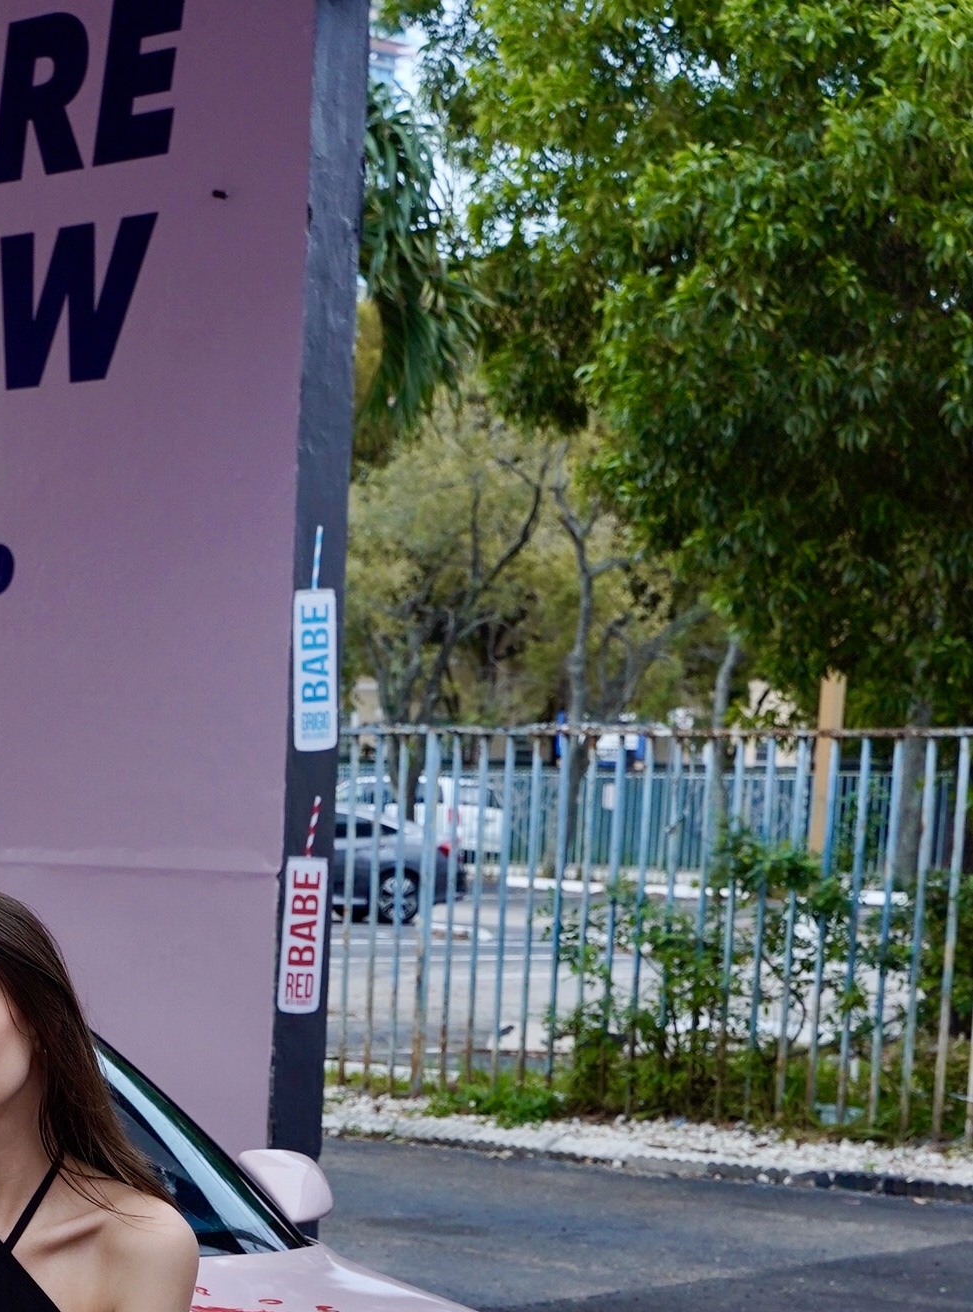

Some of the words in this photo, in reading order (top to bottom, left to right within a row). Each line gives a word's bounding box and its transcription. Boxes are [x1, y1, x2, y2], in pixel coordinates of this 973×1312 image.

[301, 604, 329, 703] BABE
[288, 870, 320, 966] BABE
[285, 973, 314, 998] RED
